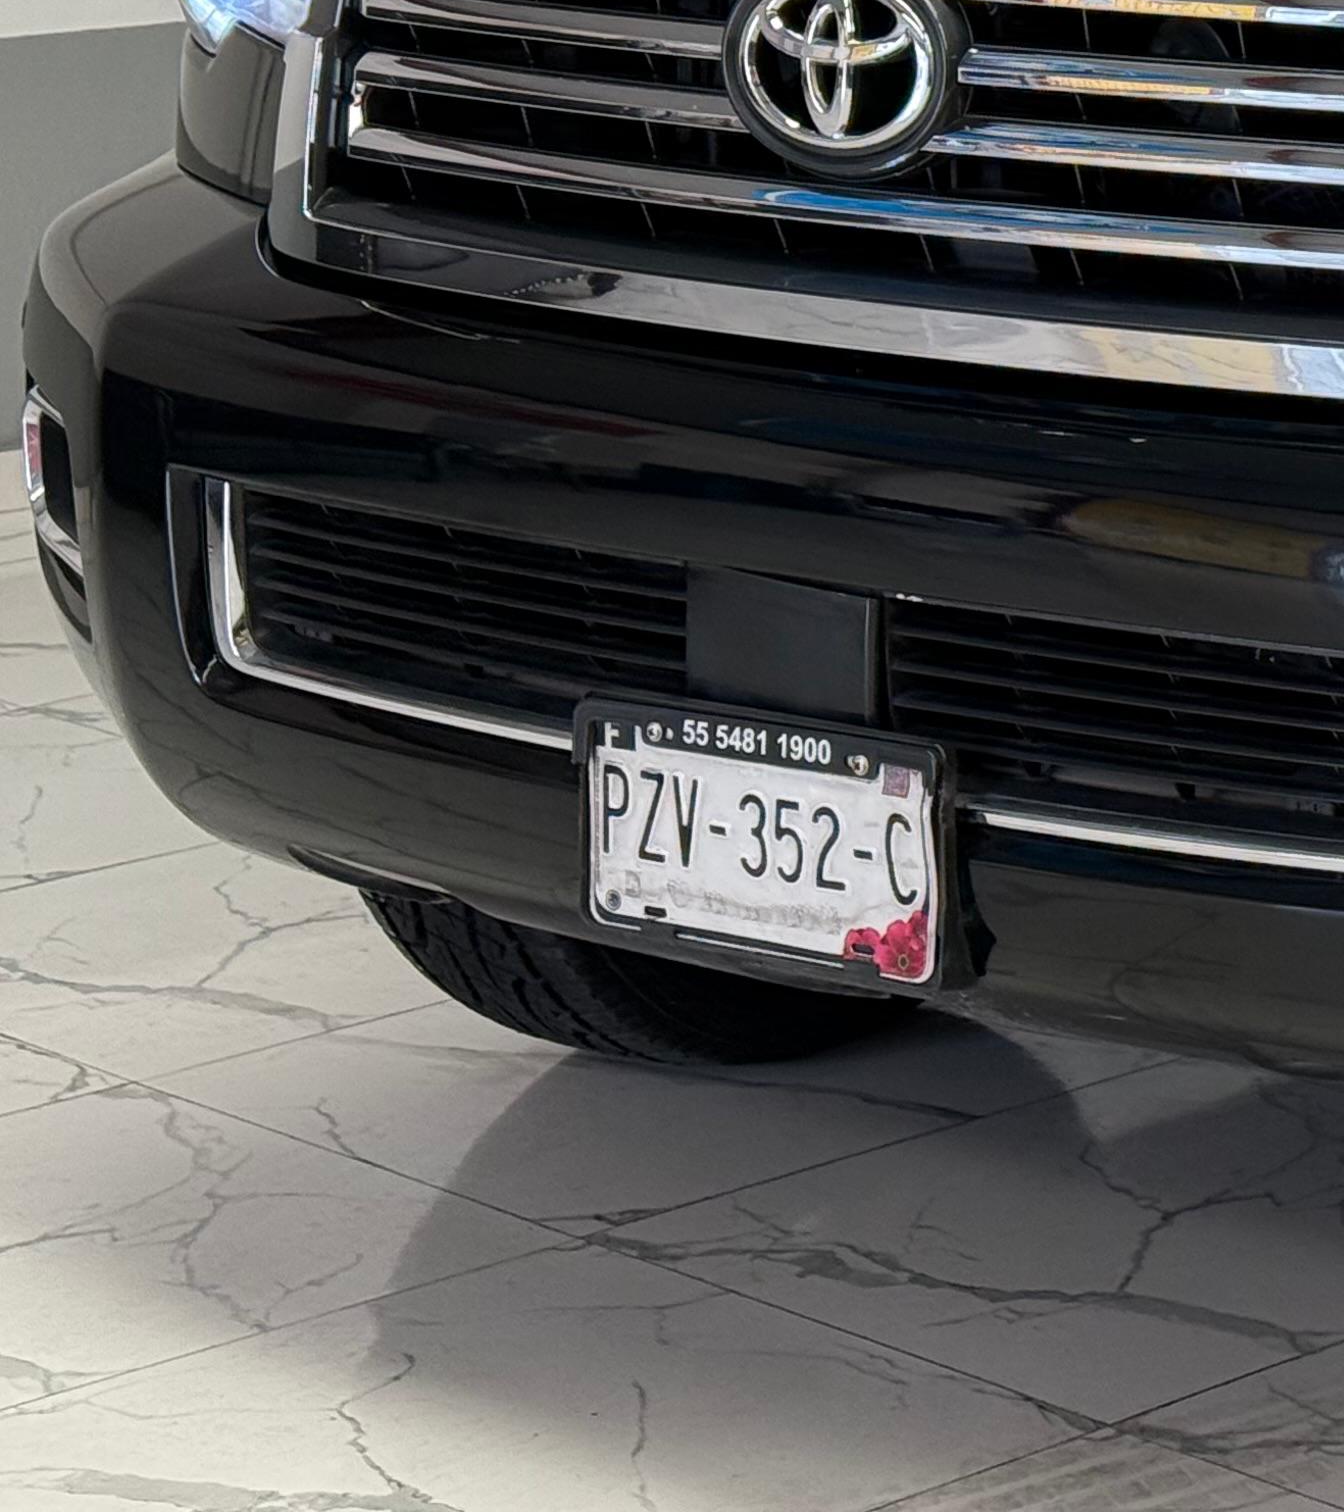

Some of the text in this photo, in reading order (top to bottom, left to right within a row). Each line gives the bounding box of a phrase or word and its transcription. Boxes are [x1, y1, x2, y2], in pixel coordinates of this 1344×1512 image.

[682, 719, 832, 765] 55 5481 1900
[602, 764, 918, 906] PZV-352-C
